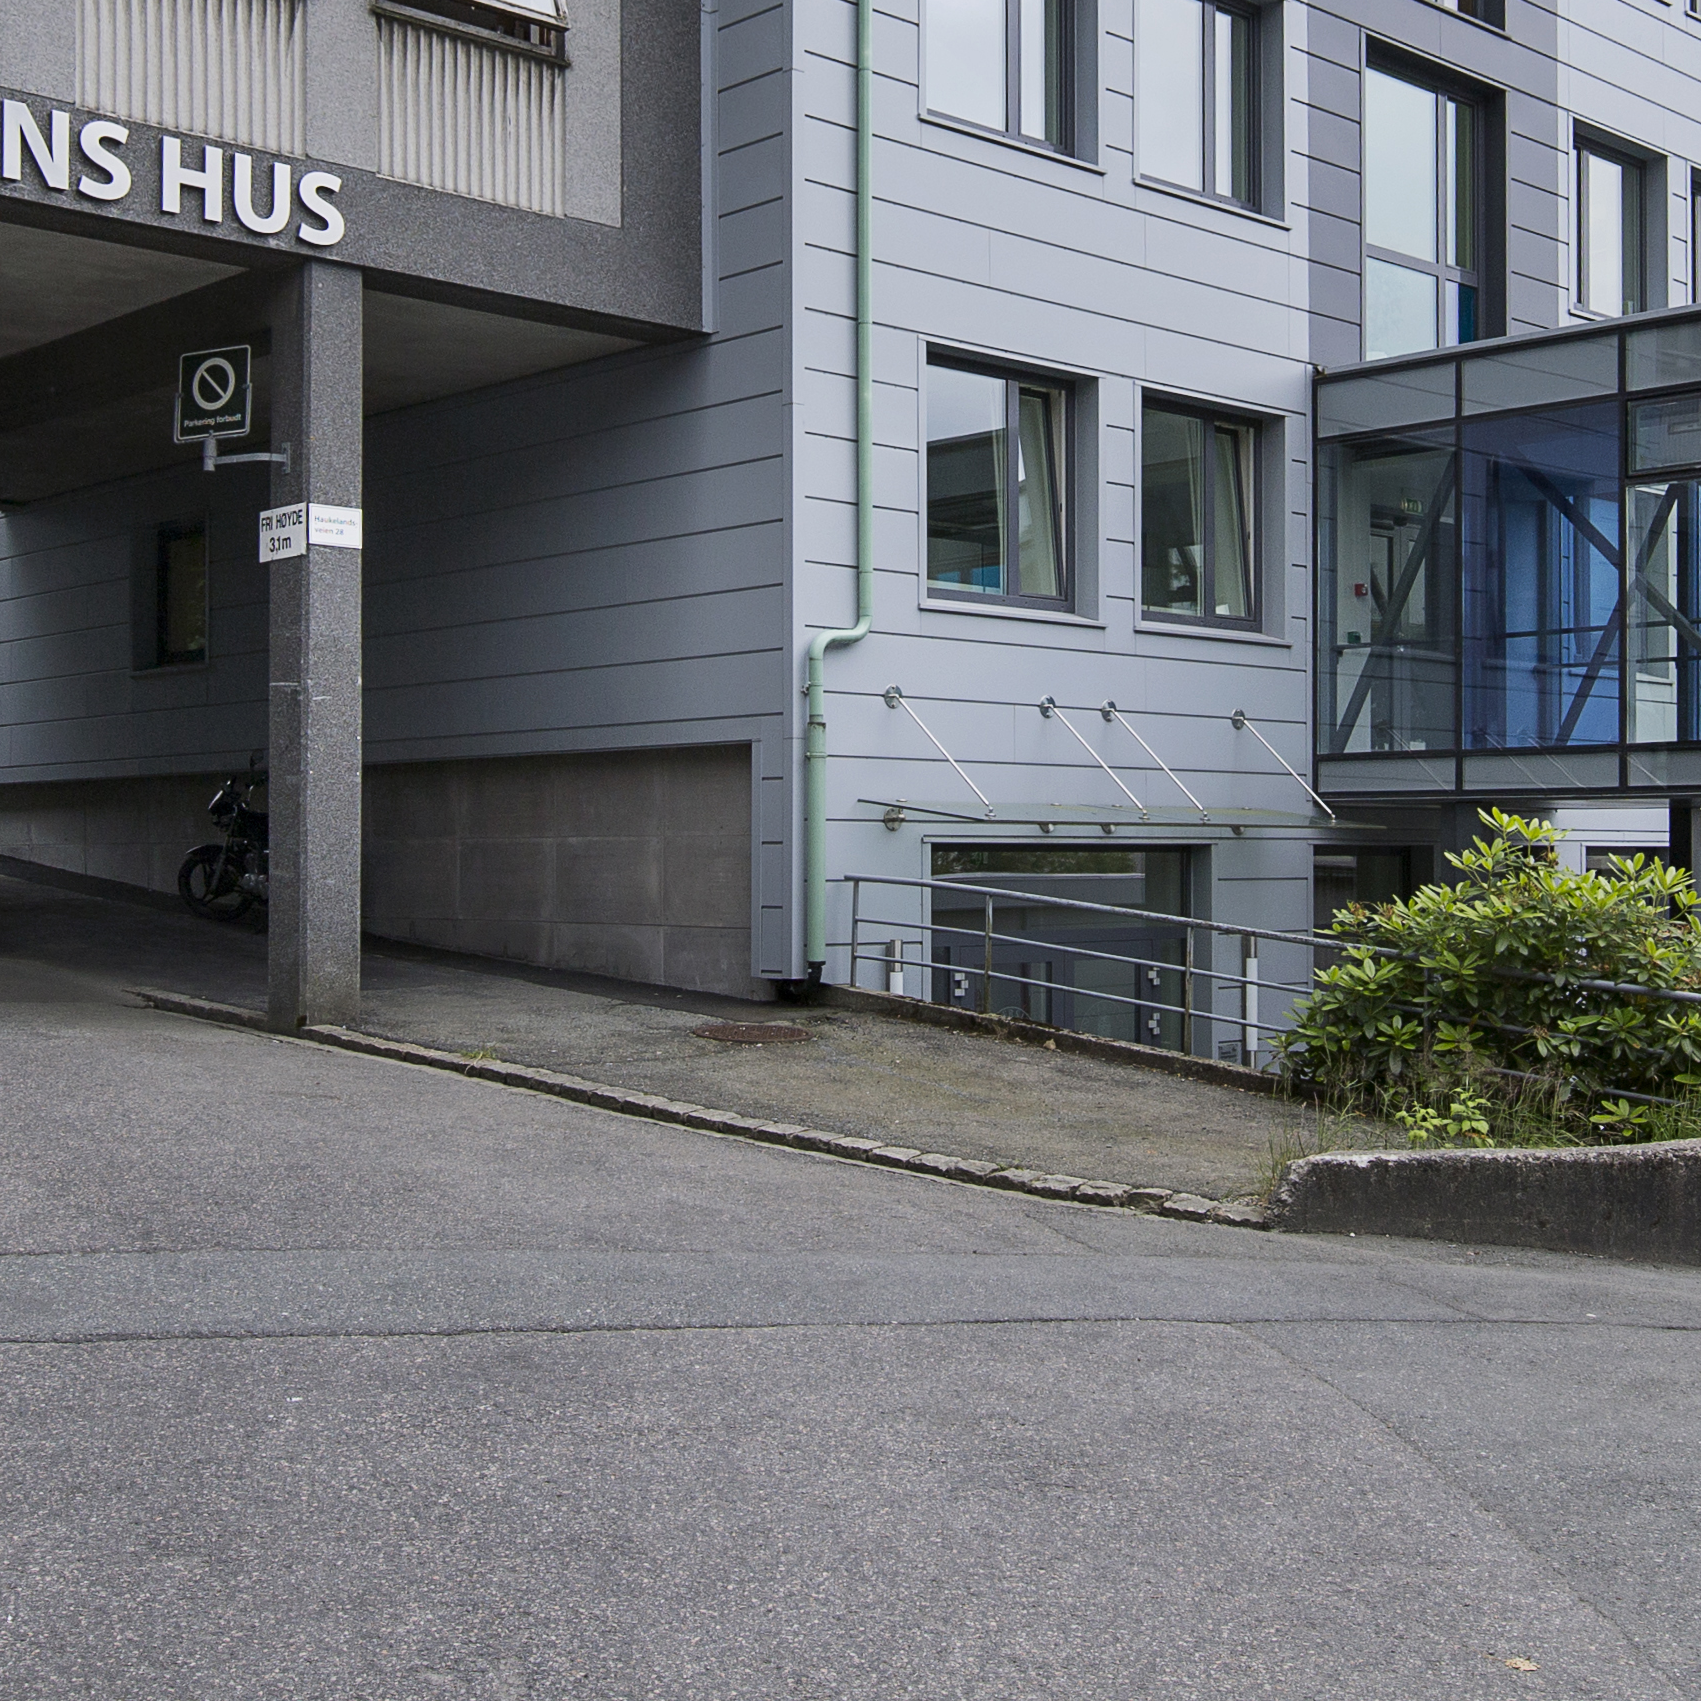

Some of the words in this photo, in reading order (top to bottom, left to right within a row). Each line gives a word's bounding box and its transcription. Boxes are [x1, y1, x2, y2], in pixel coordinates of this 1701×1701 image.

[161, 136, 345, 247] HUS
[184, 417, 215, 428] Parkering
[216, 413, 242, 423] forbudt
[261, 516, 274, 532] FRI
[276, 509, 303, 529] HØYDE
[314, 527, 334, 535] veien
[335, 527, 344, 536] 28
